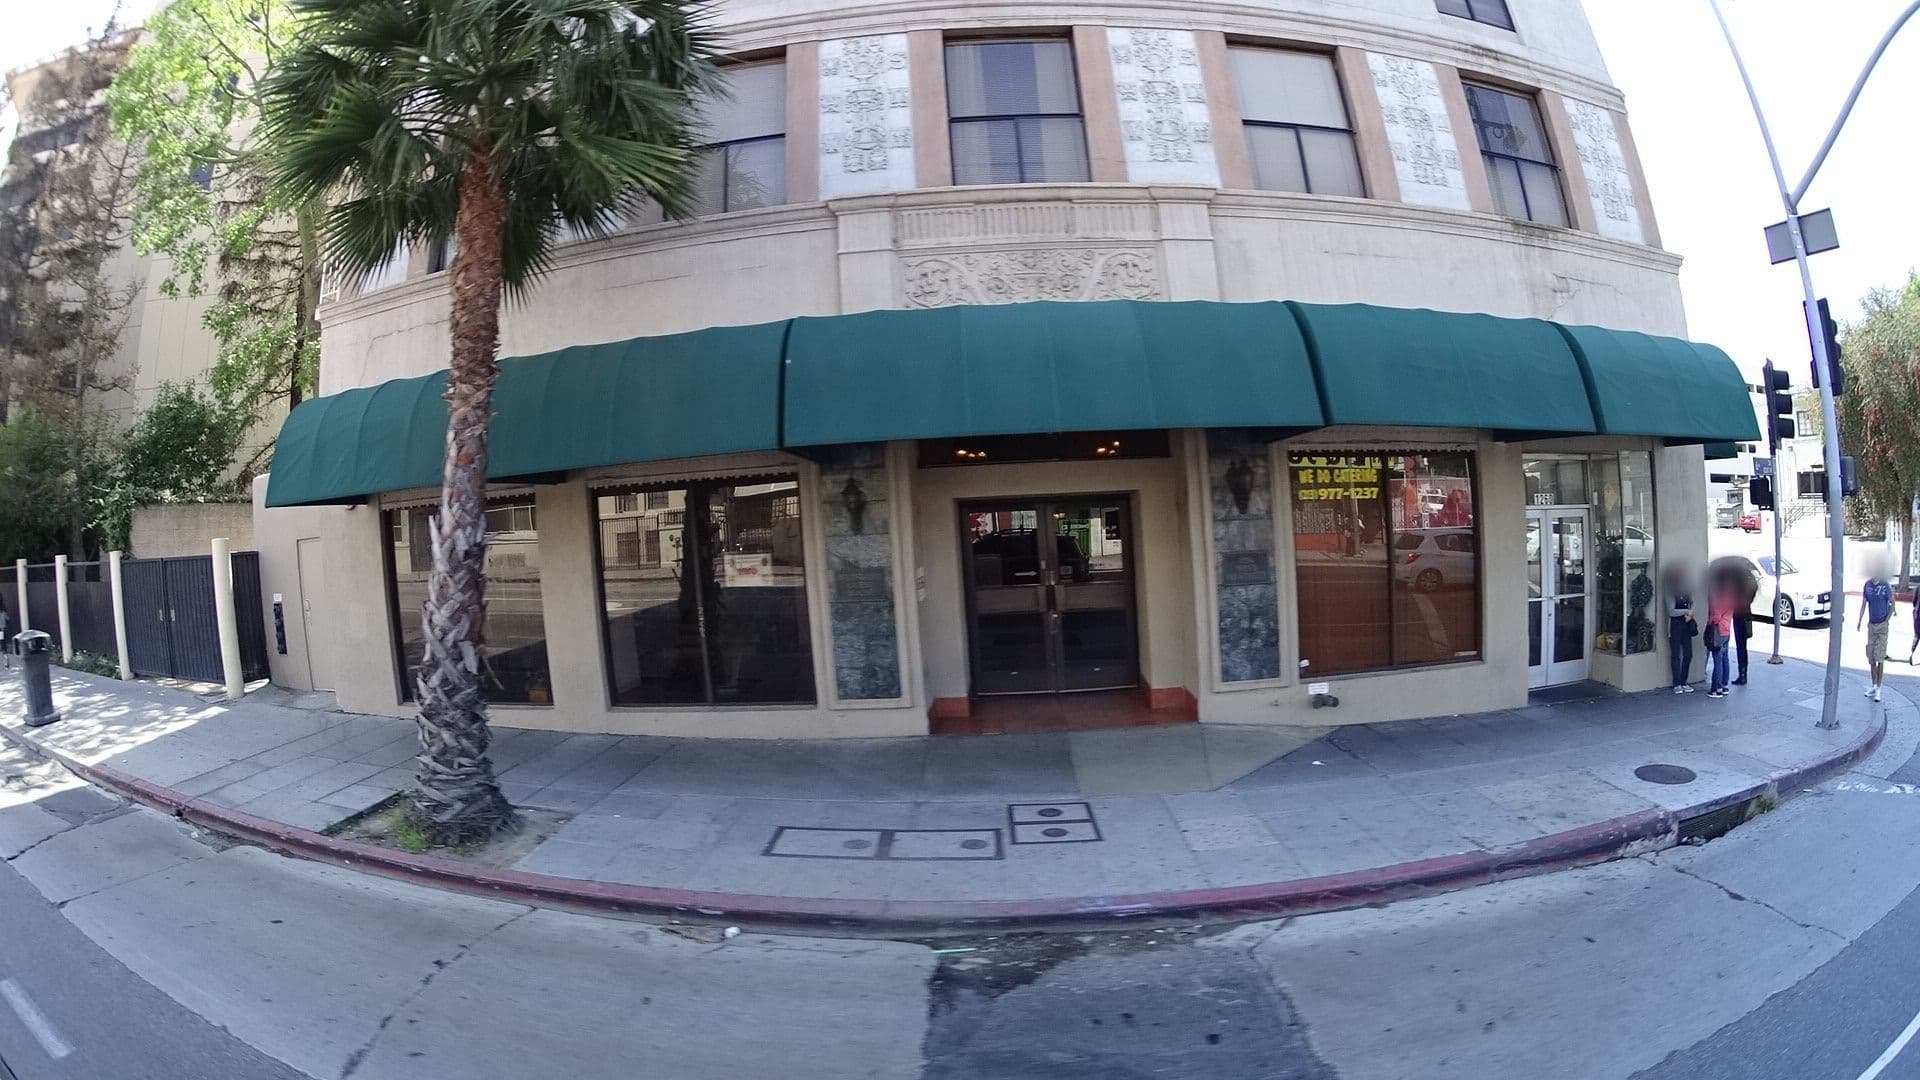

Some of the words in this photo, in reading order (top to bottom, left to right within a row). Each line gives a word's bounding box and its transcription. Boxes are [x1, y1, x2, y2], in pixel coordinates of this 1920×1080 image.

[1298, 470, 1314, 483] WE
[1317, 469, 1331, 483] DO
[1333, 468, 1379, 483] CATERING
